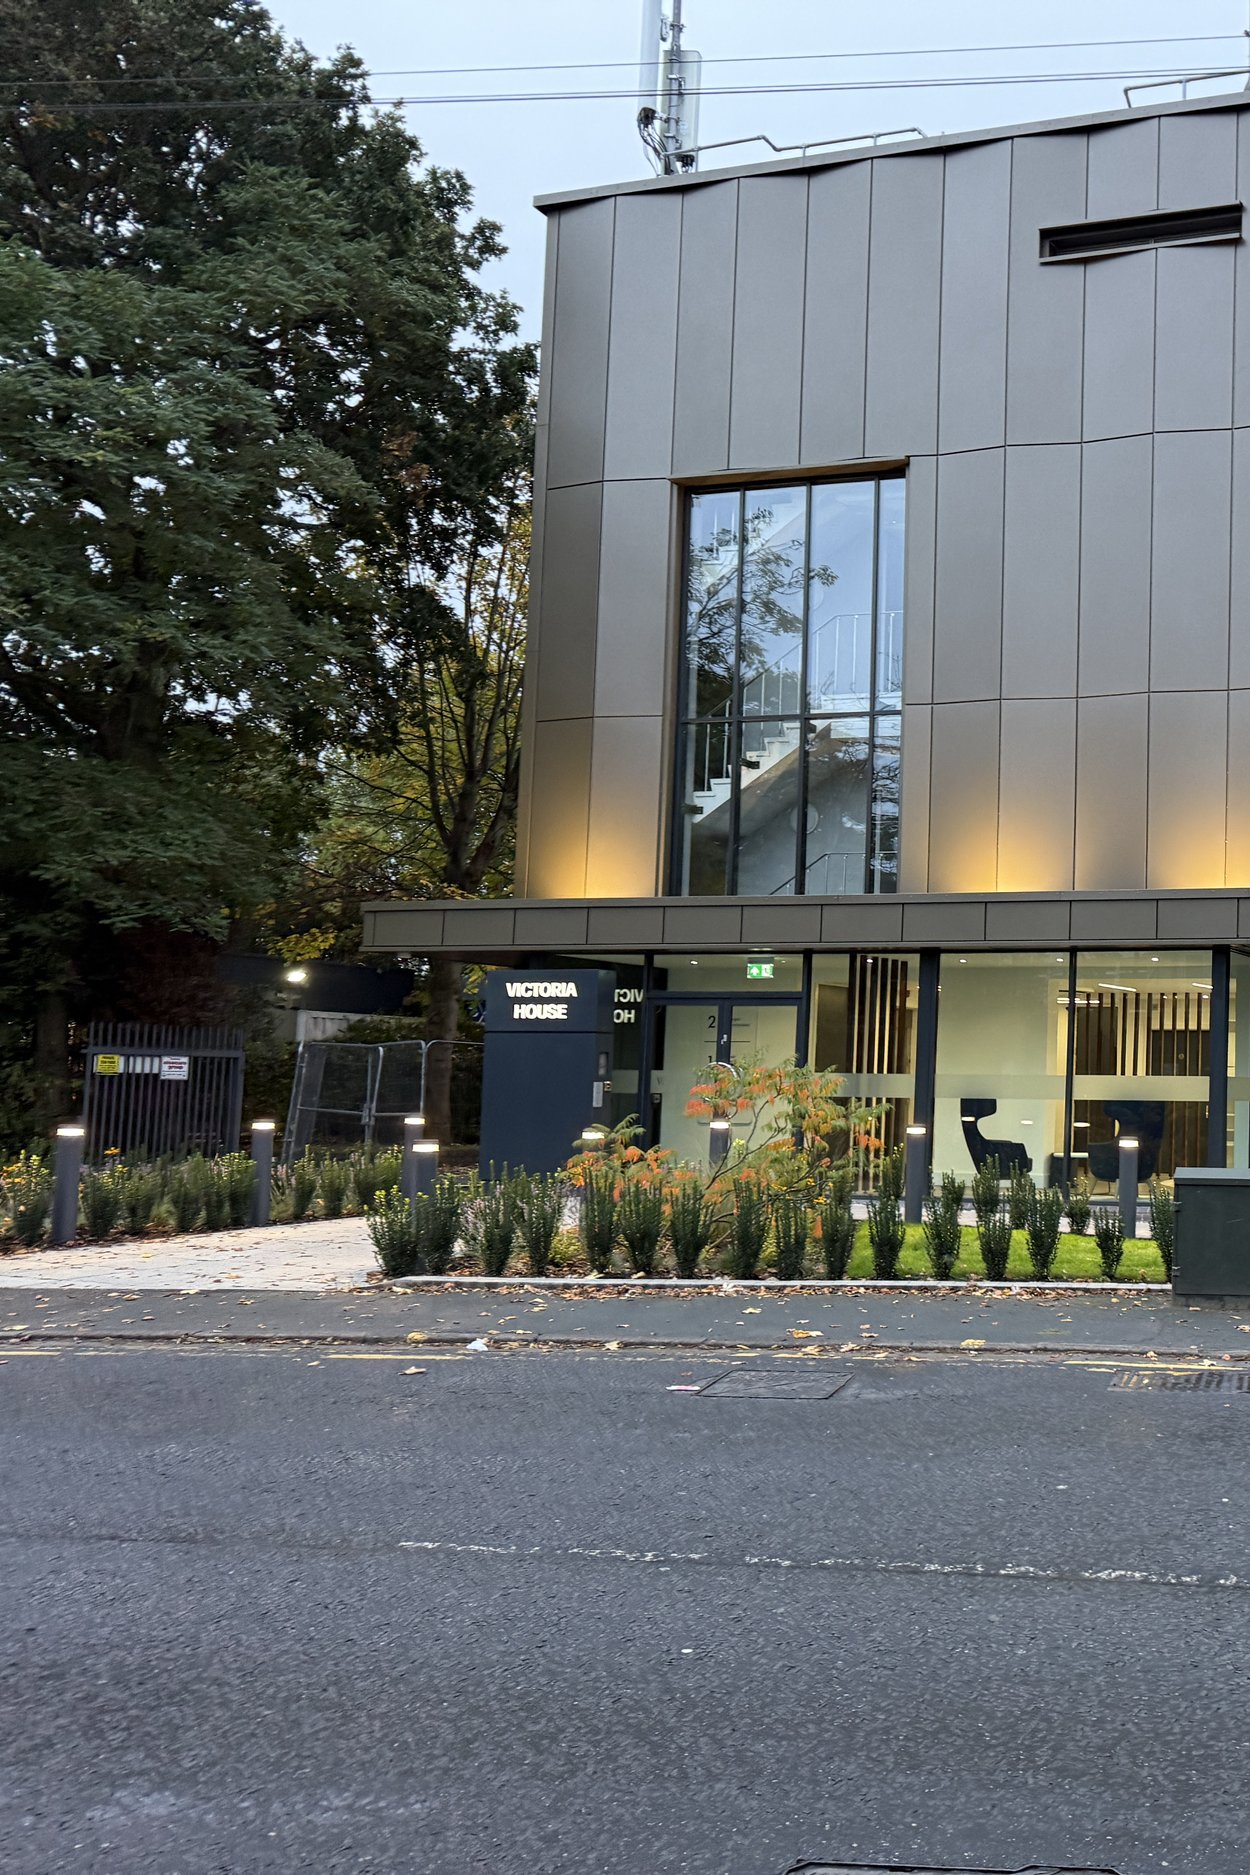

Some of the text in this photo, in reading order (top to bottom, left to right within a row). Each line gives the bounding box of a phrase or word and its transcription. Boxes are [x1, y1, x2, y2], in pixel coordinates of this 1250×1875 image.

[506, 982, 578, 998] VICTORIA
[513, 1004, 568, 1019] HOUSE
[708, 1015, 716, 1028] 2
